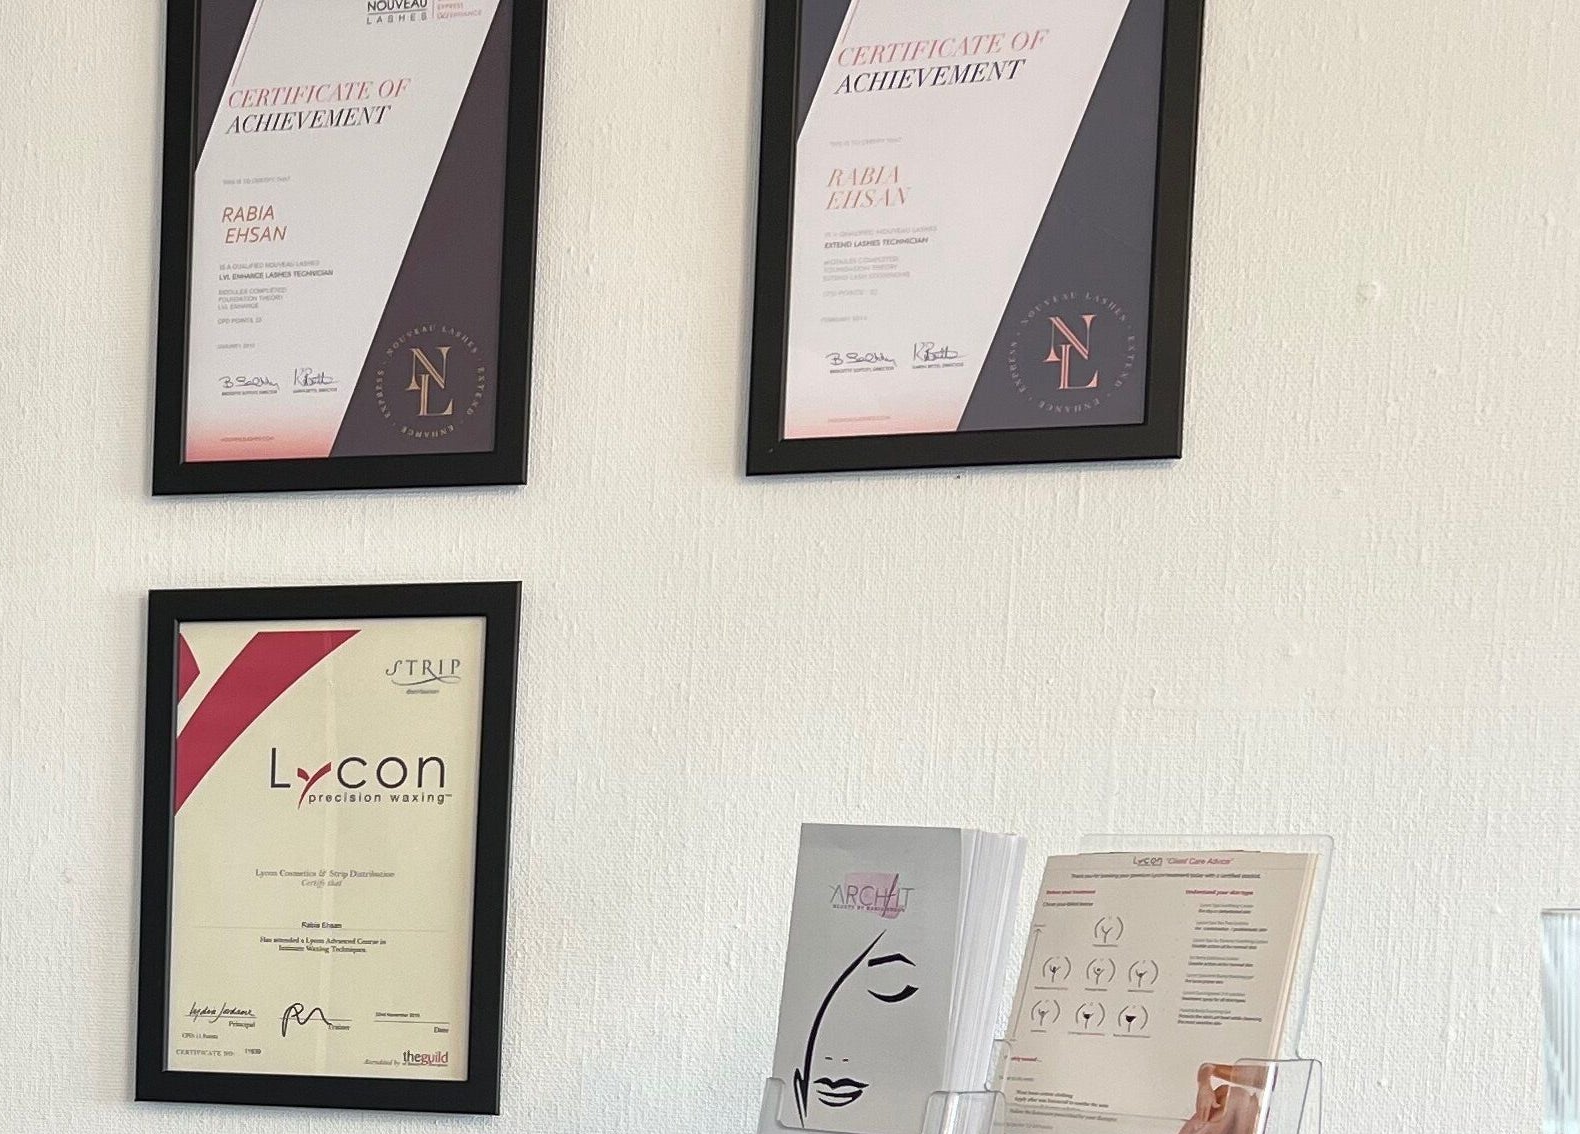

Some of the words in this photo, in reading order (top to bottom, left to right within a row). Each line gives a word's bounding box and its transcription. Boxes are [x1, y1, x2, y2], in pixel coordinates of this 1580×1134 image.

[367, 0, 427, 12] NOUVEAU
[367, 12, 426, 25] LASHES
[837, 32, 1006, 67] CERTIFICATE
[1010, 29, 1050, 50] OF
[834, 59, 1026, 94] ACHIEVEMENT
[228, 80, 373, 109] CERTIFICATE
[378, 78, 413, 98] OF
[225, 105, 392, 134] ACHIEVEMENT
[826, 165, 899, 187] RABIA
[825, 186, 911, 210] EHSAN
[222, 205, 274, 223] RABIA
[225, 226, 287, 243] EHSAN
[386, 659, 461, 680] STRIP
[270, 748, 445, 810] Lycon
[309, 792, 381, 805] precision
